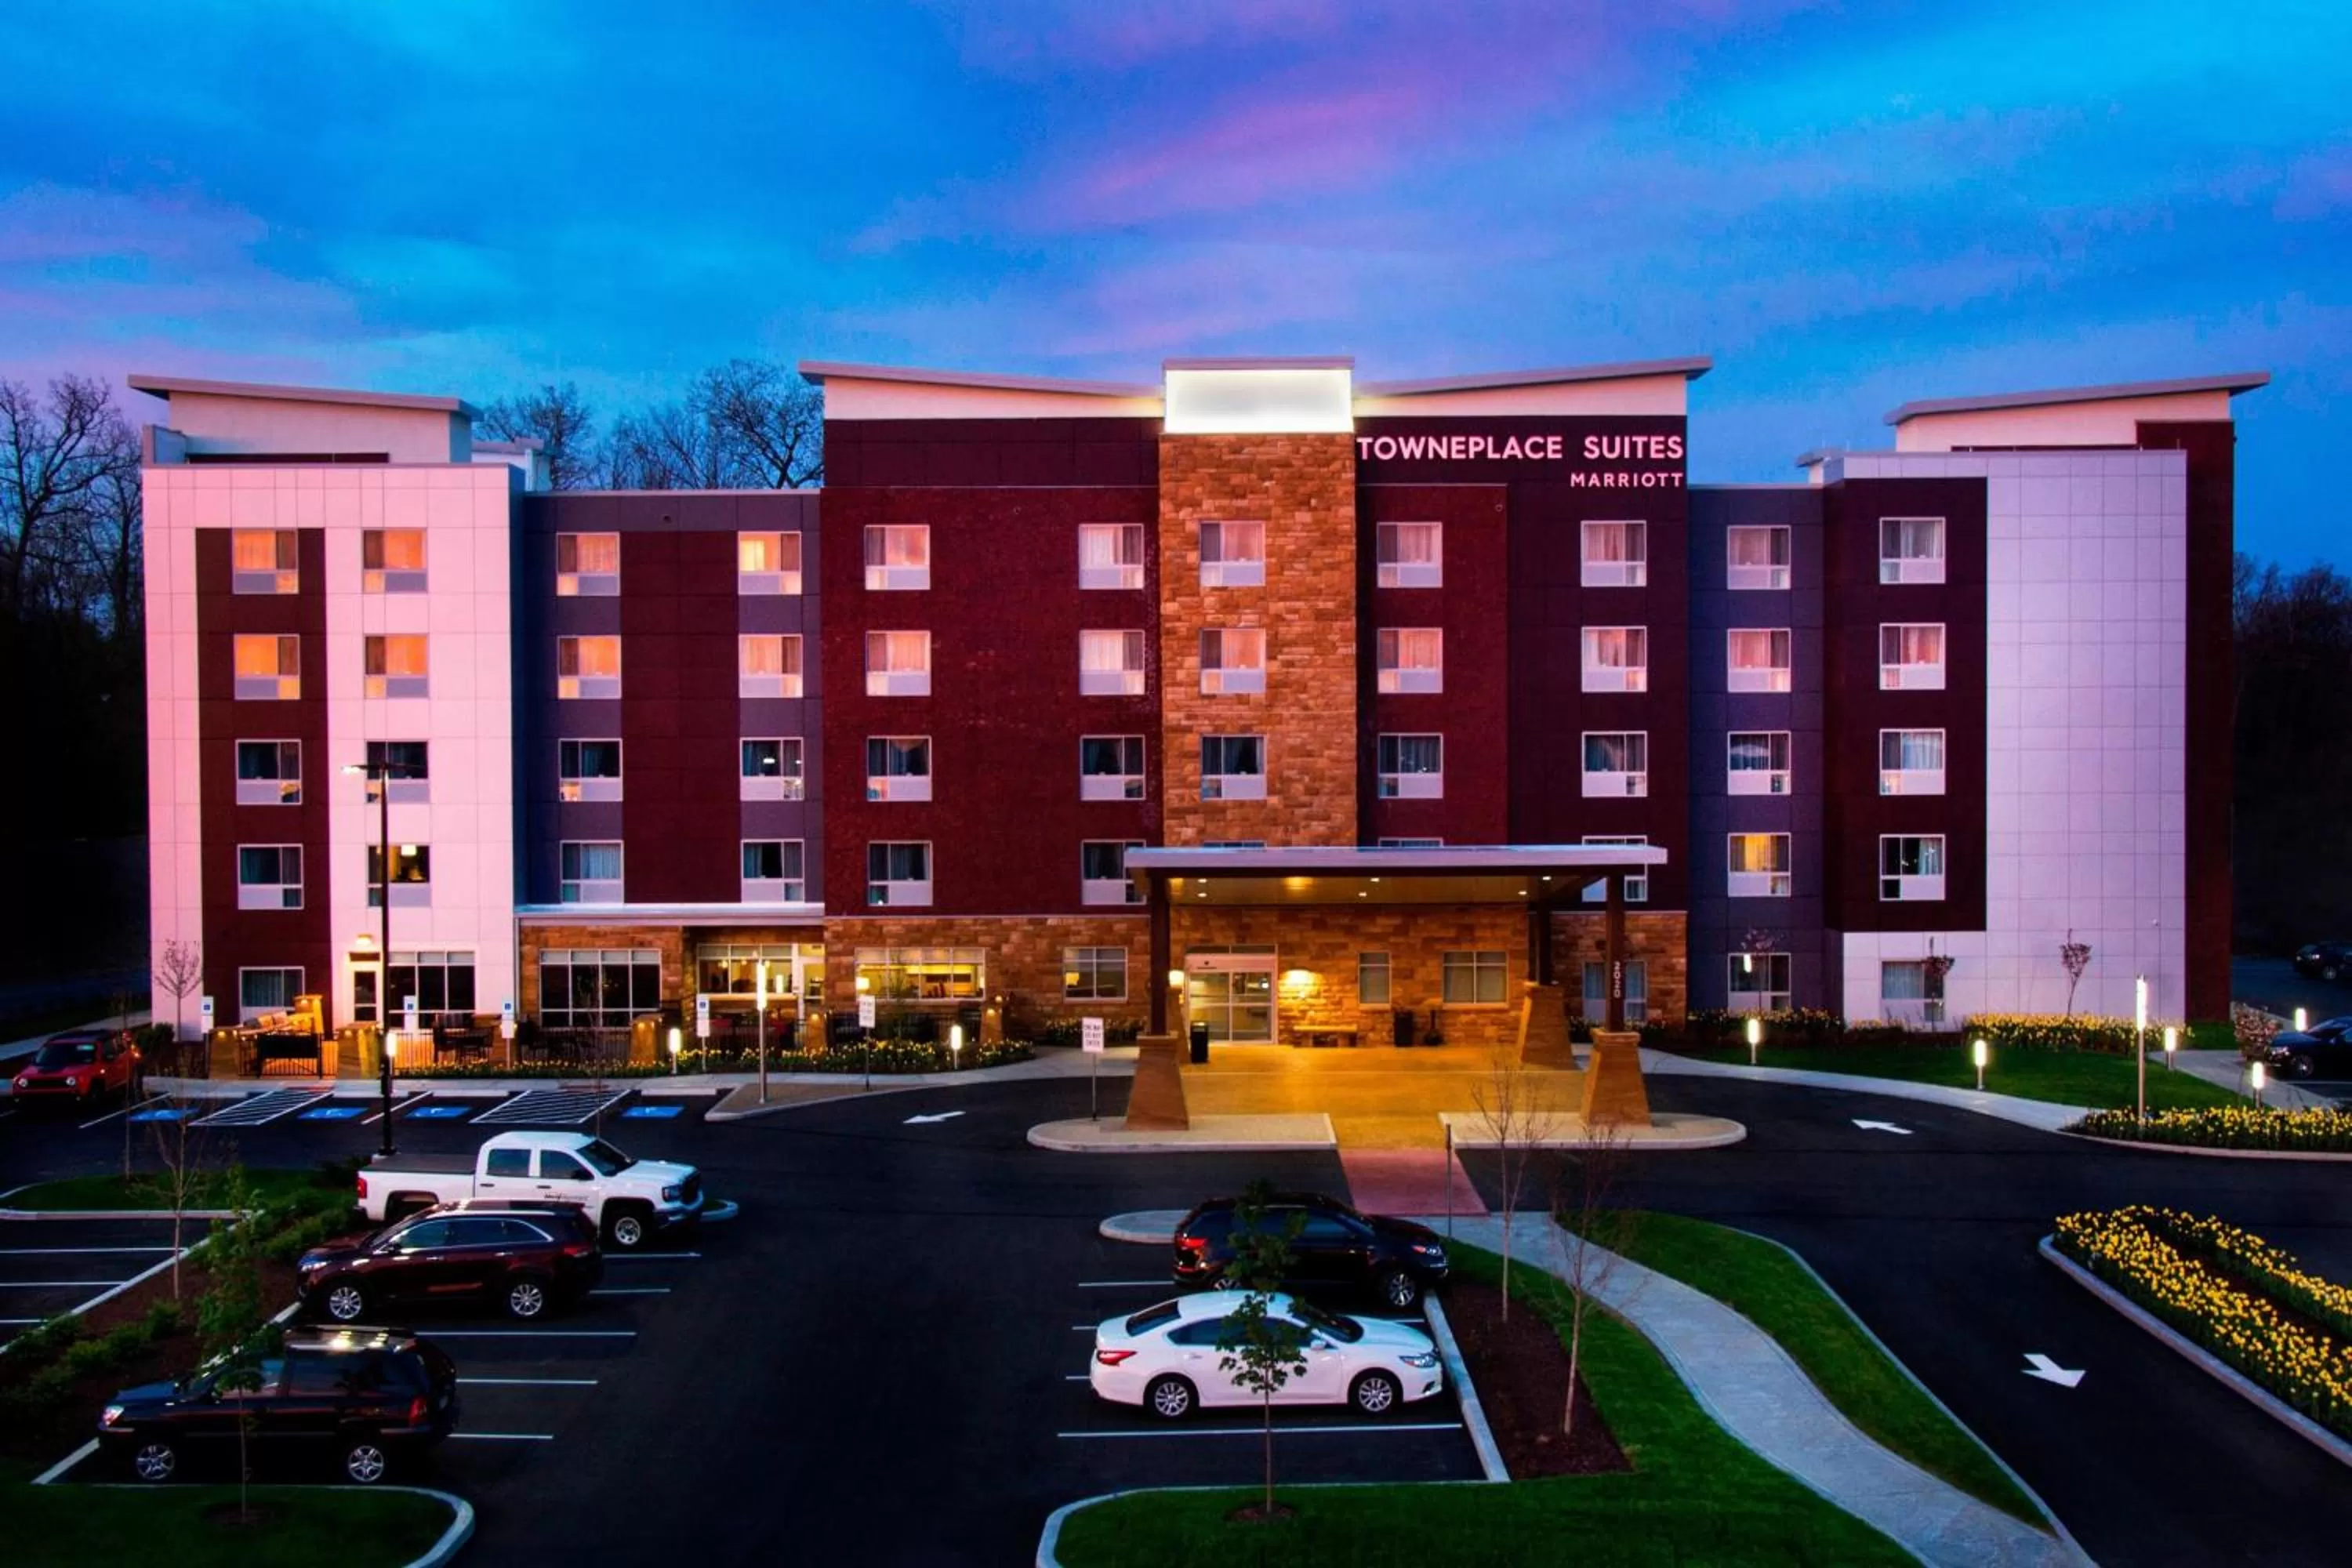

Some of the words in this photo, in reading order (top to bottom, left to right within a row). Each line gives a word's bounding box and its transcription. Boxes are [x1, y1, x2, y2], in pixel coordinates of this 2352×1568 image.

[1356, 436, 1563, 460] TOWNEPLACE
[1584, 436, 1683, 459] SUITES
[1570, 473, 1683, 487] MARRIOTT
